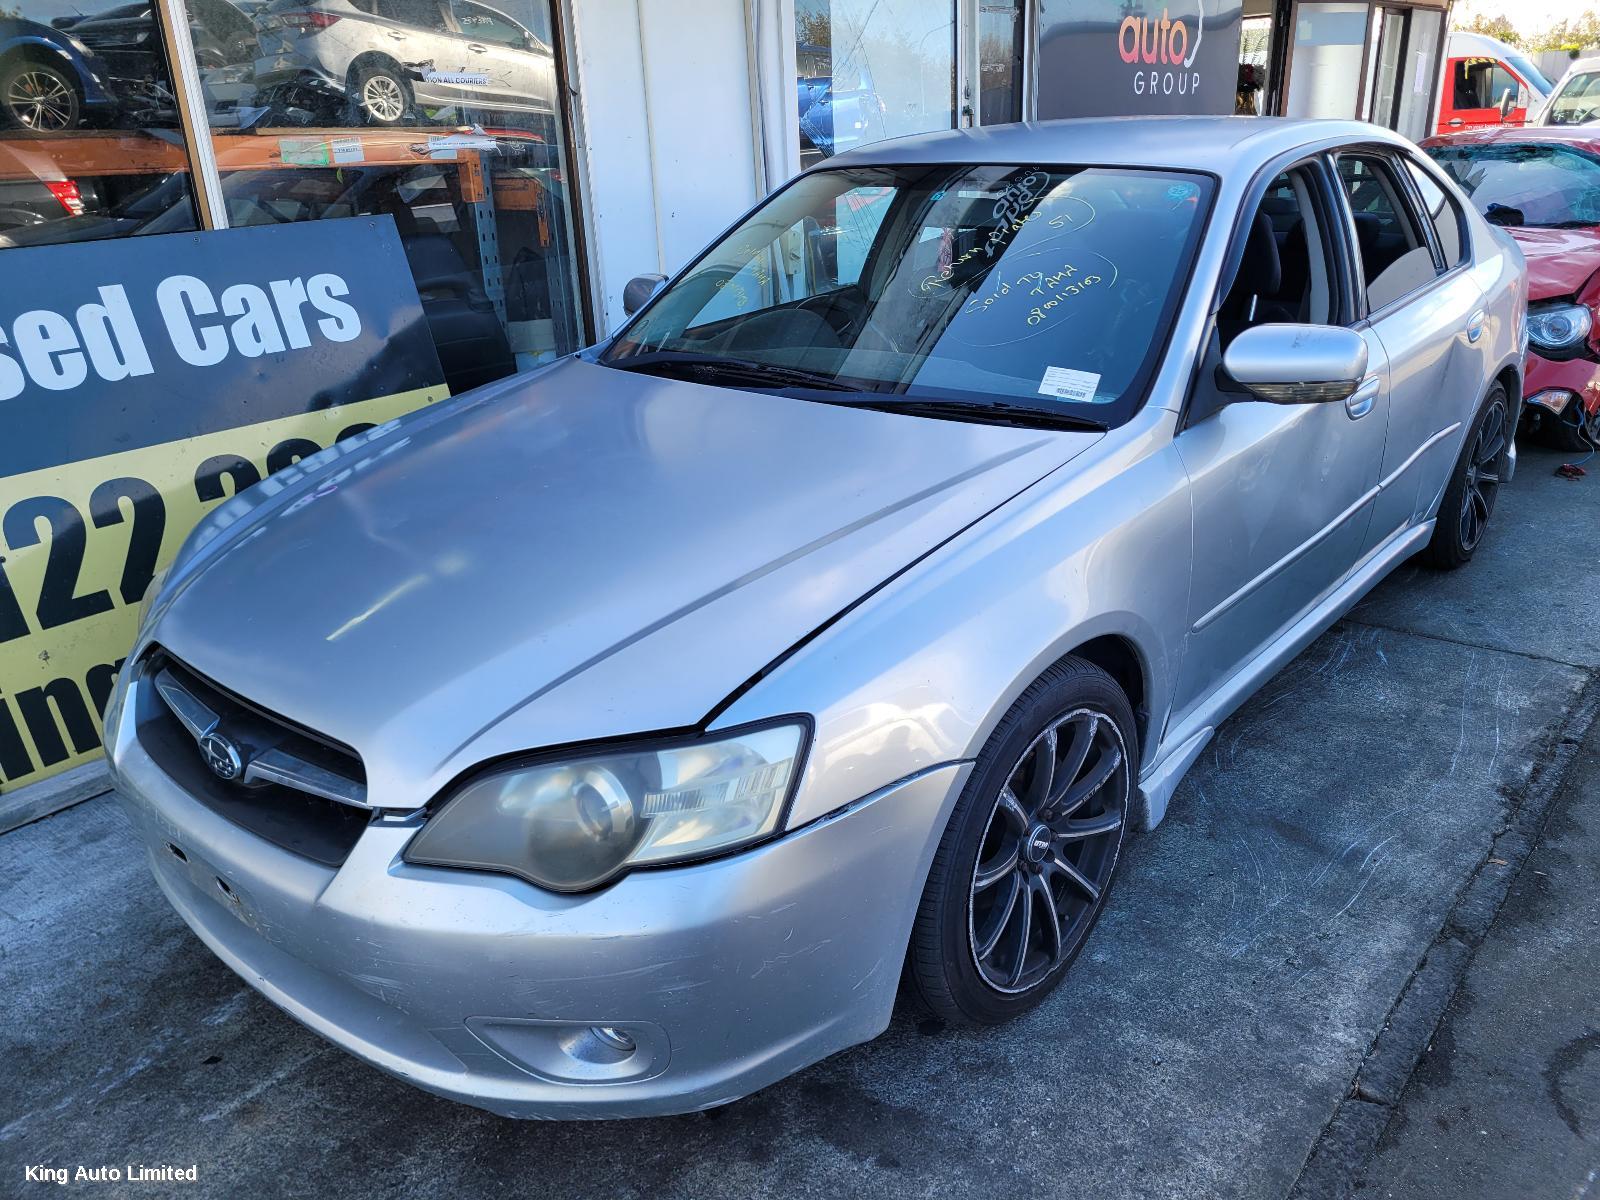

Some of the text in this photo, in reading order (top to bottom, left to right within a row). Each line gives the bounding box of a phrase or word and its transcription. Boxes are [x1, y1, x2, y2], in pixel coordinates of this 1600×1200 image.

[1119, 8, 1188, 65] auto
[455, 77, 487, 85] COURIERS
[1134, 71, 1200, 95] GROUP
[1030, 264, 1078, 297] TAHA
[156, 273, 362, 367] Cars
